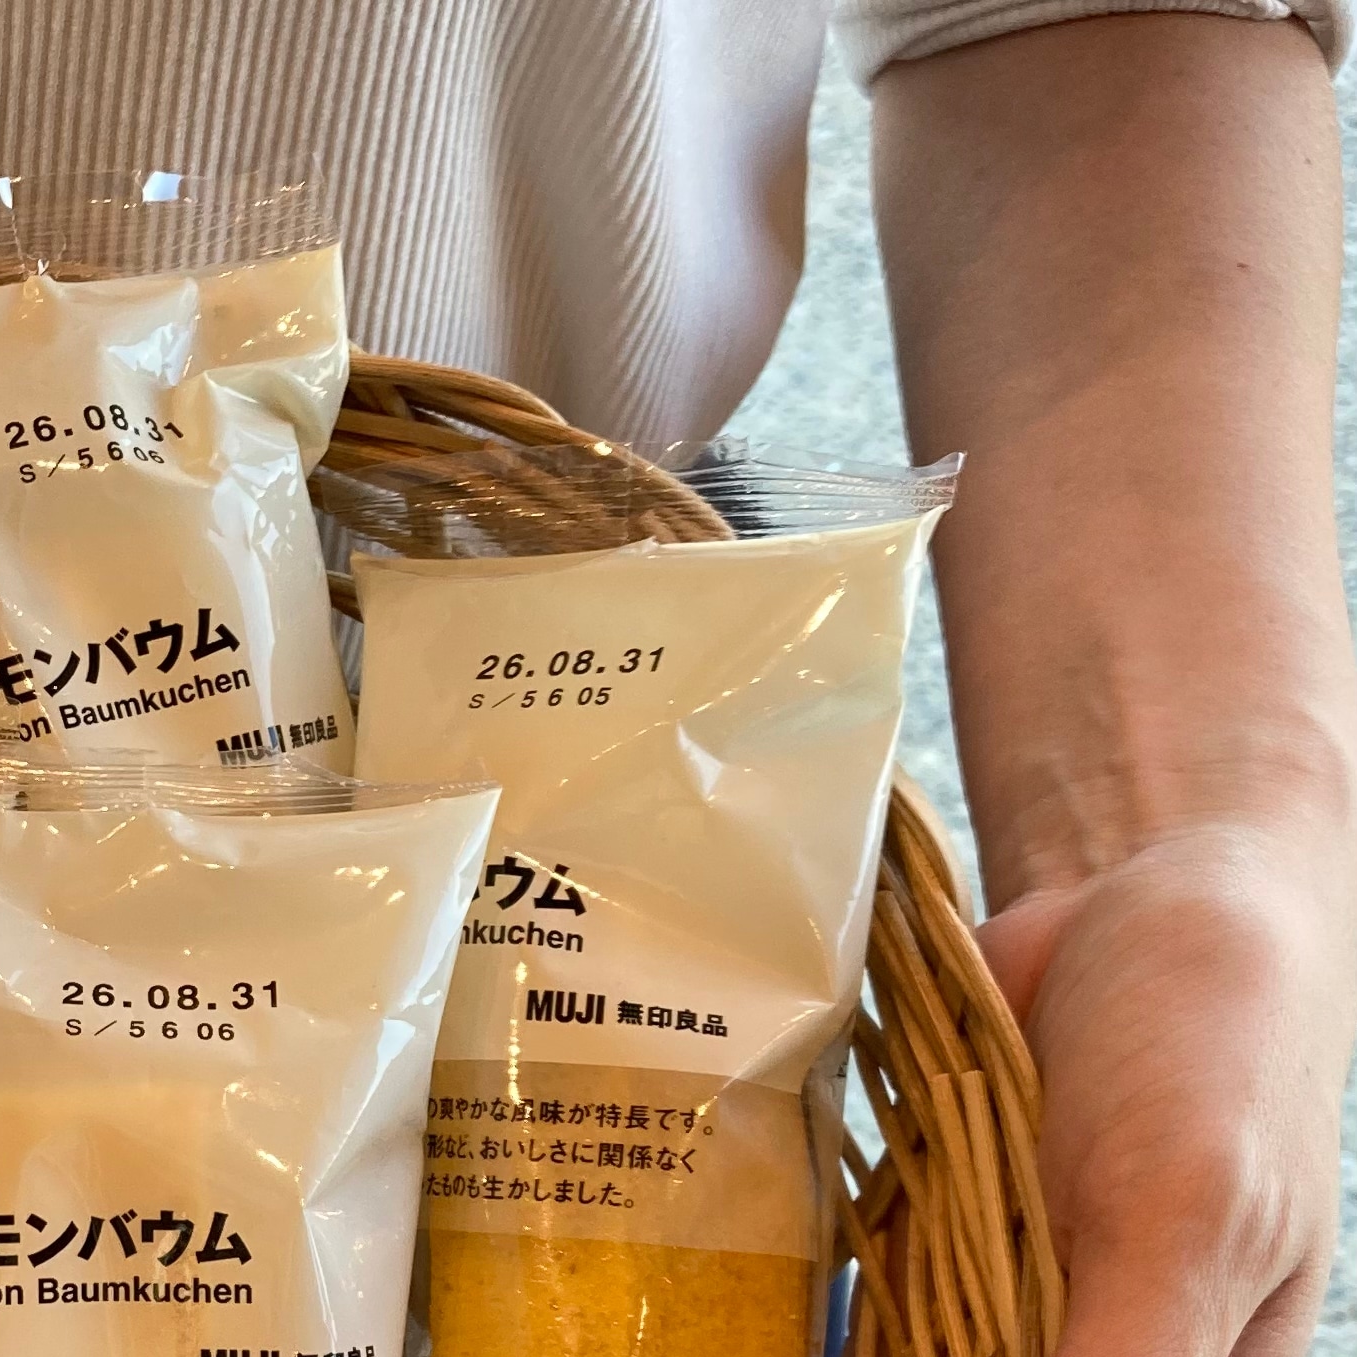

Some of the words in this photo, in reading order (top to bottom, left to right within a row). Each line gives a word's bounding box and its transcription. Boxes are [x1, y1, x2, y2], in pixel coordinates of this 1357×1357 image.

[4, 404, 184, 450] 26.08.31
[475, 646, 665, 680] 26.08.31
[59, 668, 251, 730] Baumkuchen
[216, 725, 286, 769] MUJI
[288, 714, 339, 750] 無印良品
[472, 855, 586, 917] ウム
[61, 980, 279, 1011] 26.08.31
[525, 989, 606, 1025] MUJI
[616, 1000, 728, 1037] 無印良品
[422, 1172, 634, 1210] たものも生かしました。
[38, 1276, 253, 1304] Baumkuchen
